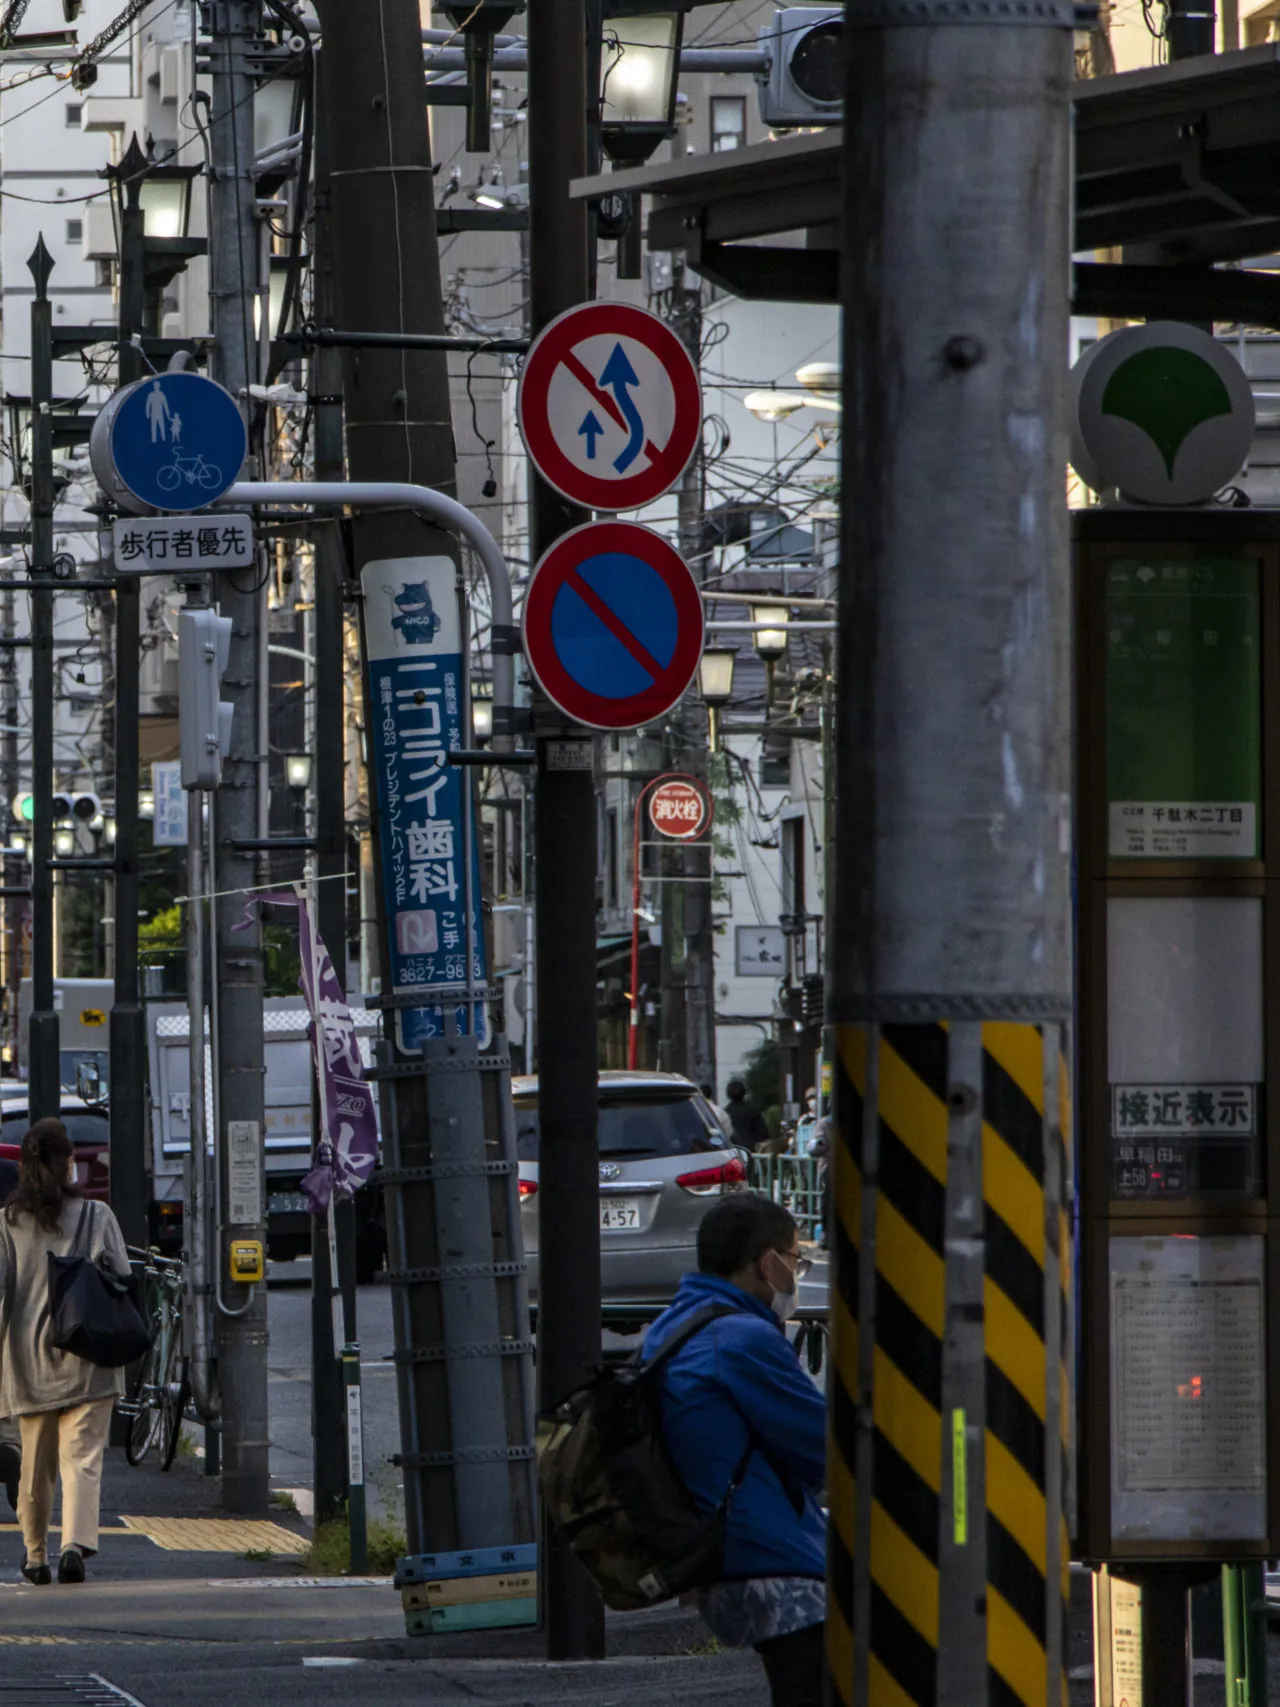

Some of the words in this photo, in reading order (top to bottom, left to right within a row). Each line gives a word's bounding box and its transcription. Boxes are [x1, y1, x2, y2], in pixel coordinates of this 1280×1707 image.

[120, 526, 246, 561] 歩行者優先
[395, 662, 459, 905] ニコライ歯科
[656, 800, 698, 820] 消火栓
[1152, 808, 1243, 823] 千駄木二丁目
[400, 963, 481, 984] 3827-983
[1119, 1090, 1249, 1127] 接近表示
